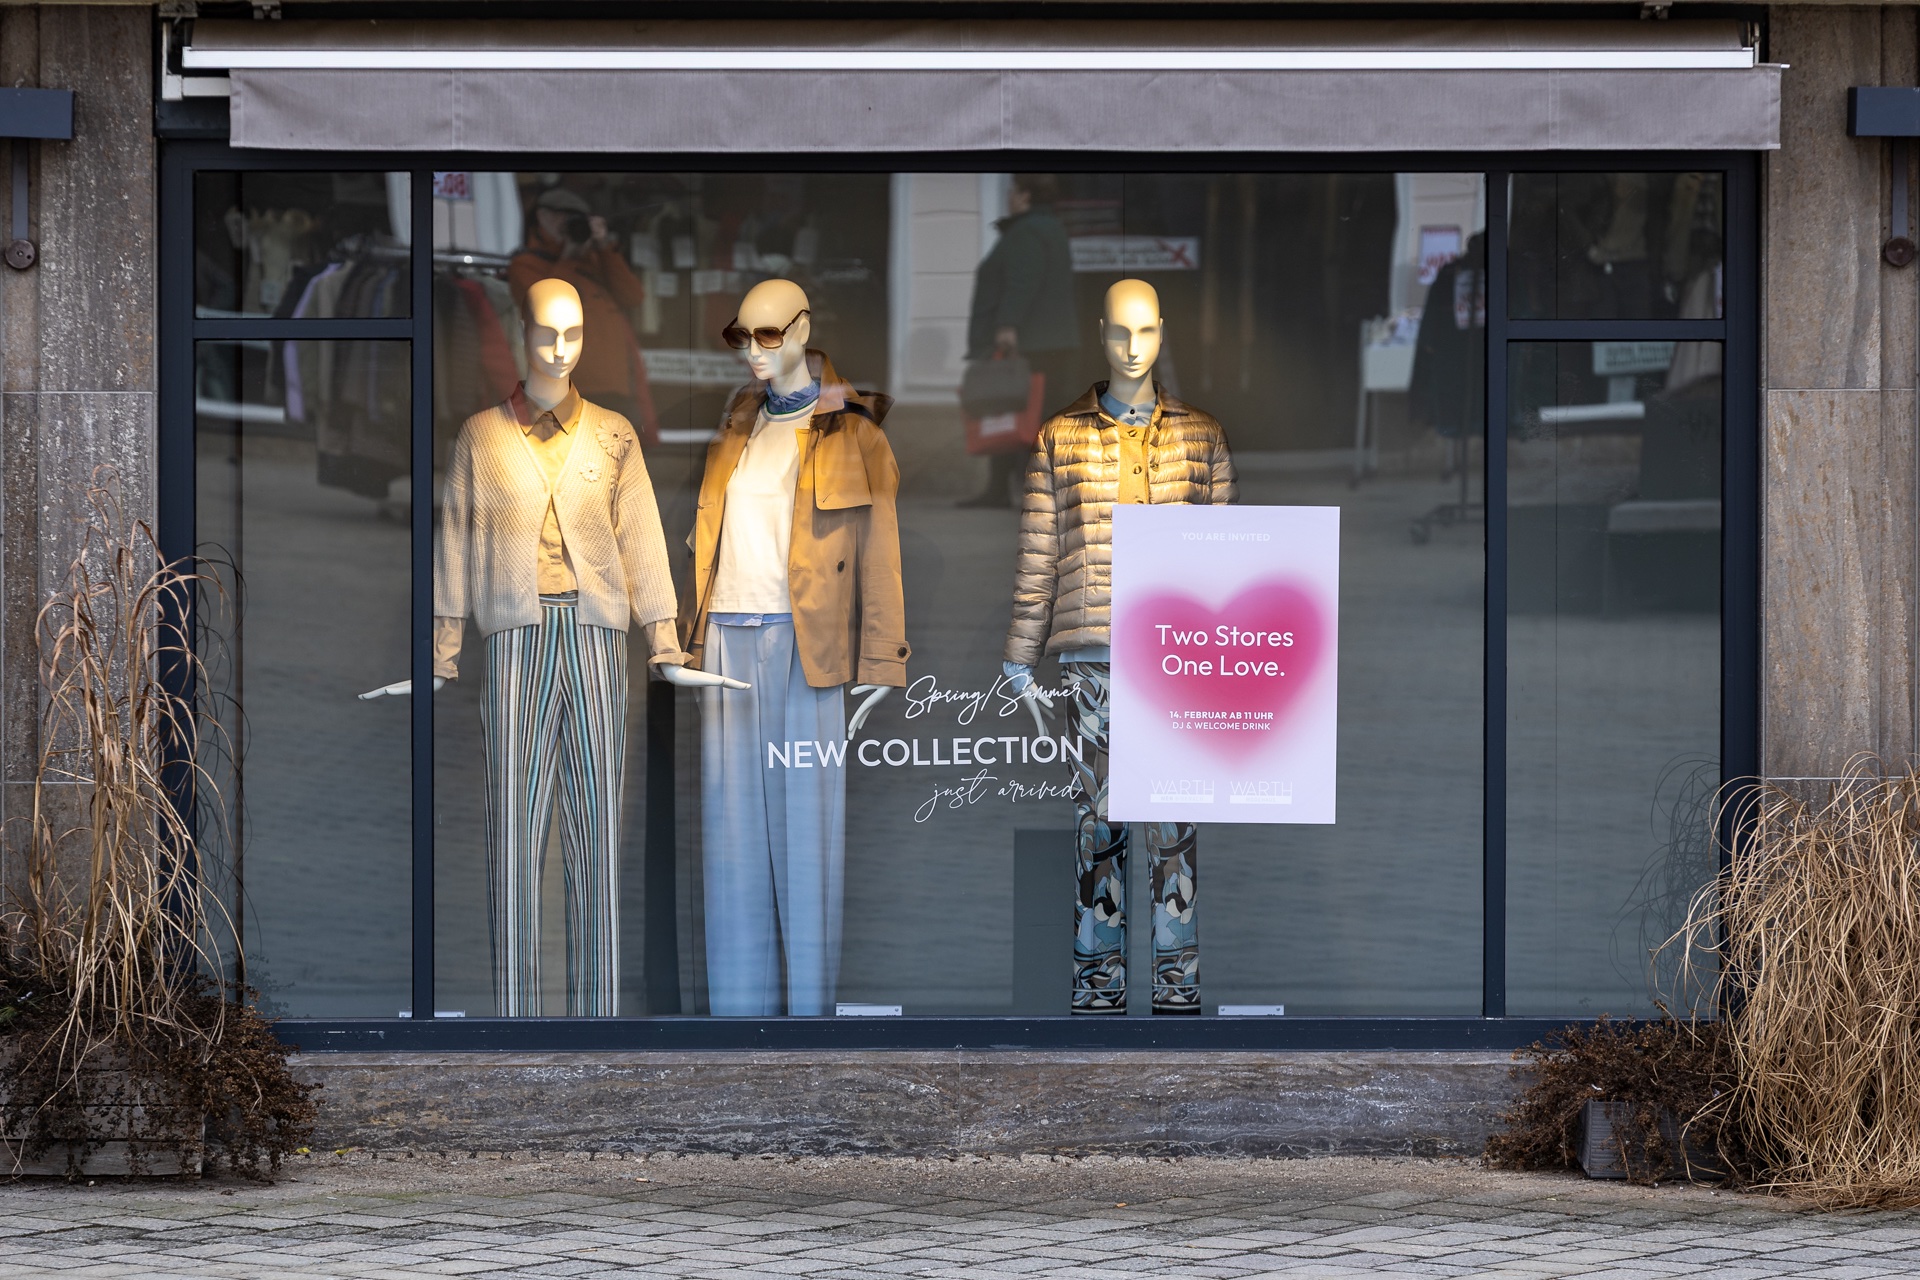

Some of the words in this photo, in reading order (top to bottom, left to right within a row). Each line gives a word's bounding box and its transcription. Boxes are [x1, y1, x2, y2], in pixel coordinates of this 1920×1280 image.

[1181, 532, 1203, 541] YOU
[1205, 532, 1226, 541] ARE
[1228, 533, 1271, 542] INVITED
[1155, 624, 1209, 646] Two
[1214, 625, 1294, 647] Stores
[1161, 654, 1213, 676] One
[1220, 655, 1285, 677] Love.
[1169, 711, 1182, 719] 14.
[1184, 711, 1227, 719] FEBRUAR
[1229, 711, 1242, 719] AB
[1244, 711, 1251, 719] 11
[1254, 712, 1274, 720] UHR
[1172, 721, 1184, 729] DJ
[1194, 722, 1240, 730] WELCOME
[1242, 722, 1271, 730] DRINK
[768, 740, 849, 769] NEW
[857, 735, 1084, 767] COLLECTION
[1150, 779, 1215, 795] WARTH
[1229, 780, 1293, 796] WARTH
[914, 768, 998, 823] just
[997, 771, 1084, 803] arrived
